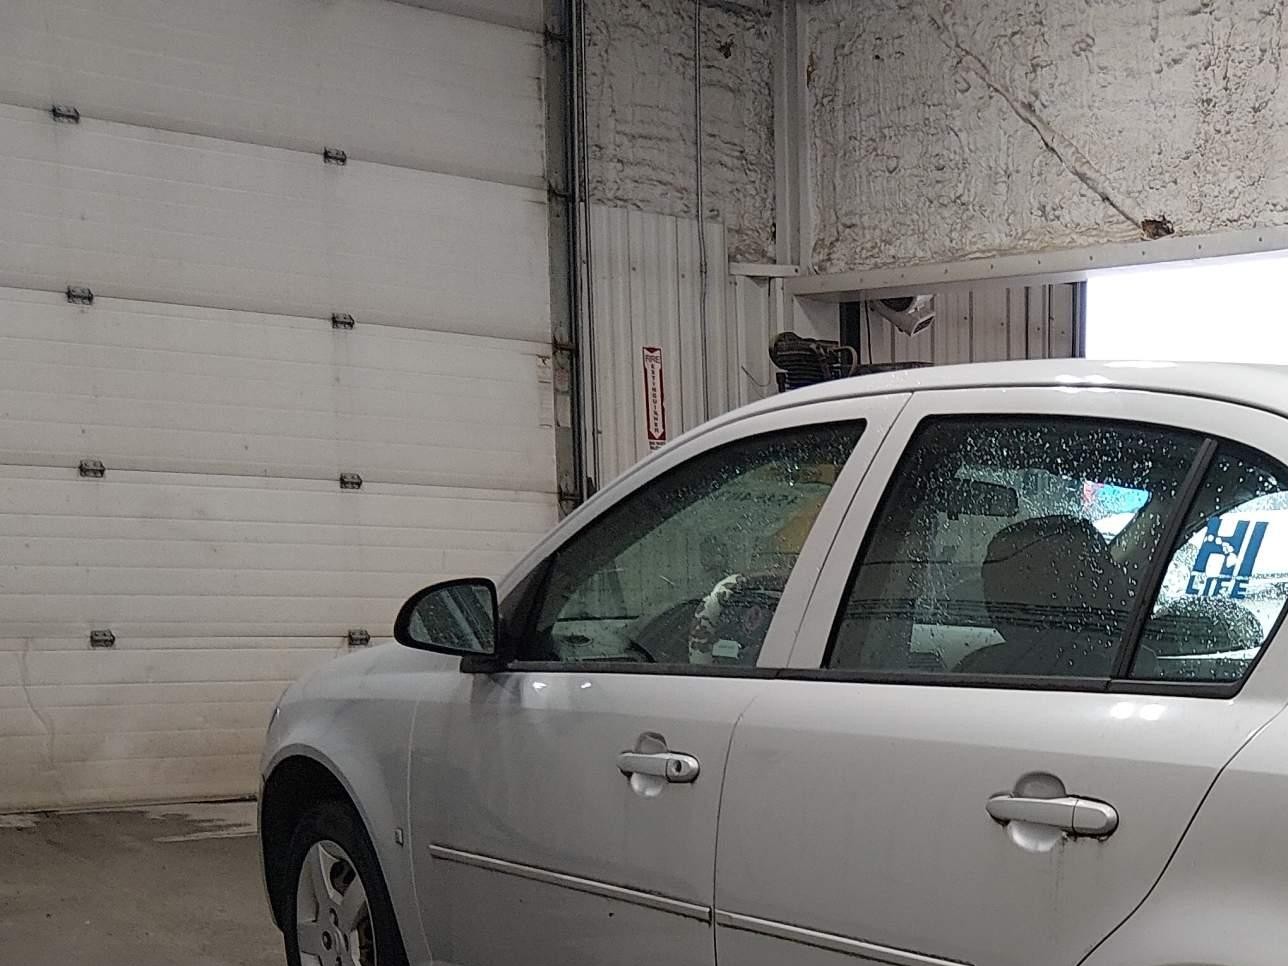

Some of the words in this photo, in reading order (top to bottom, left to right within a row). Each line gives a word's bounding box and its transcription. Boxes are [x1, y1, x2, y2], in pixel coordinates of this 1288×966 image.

[645, 354, 661, 364] FIRE
[650, 363, 660, 433] EXTINGUISHER
[1192, 514, 1269, 576] HI
[1185, 575, 1249, 600] LIFE
